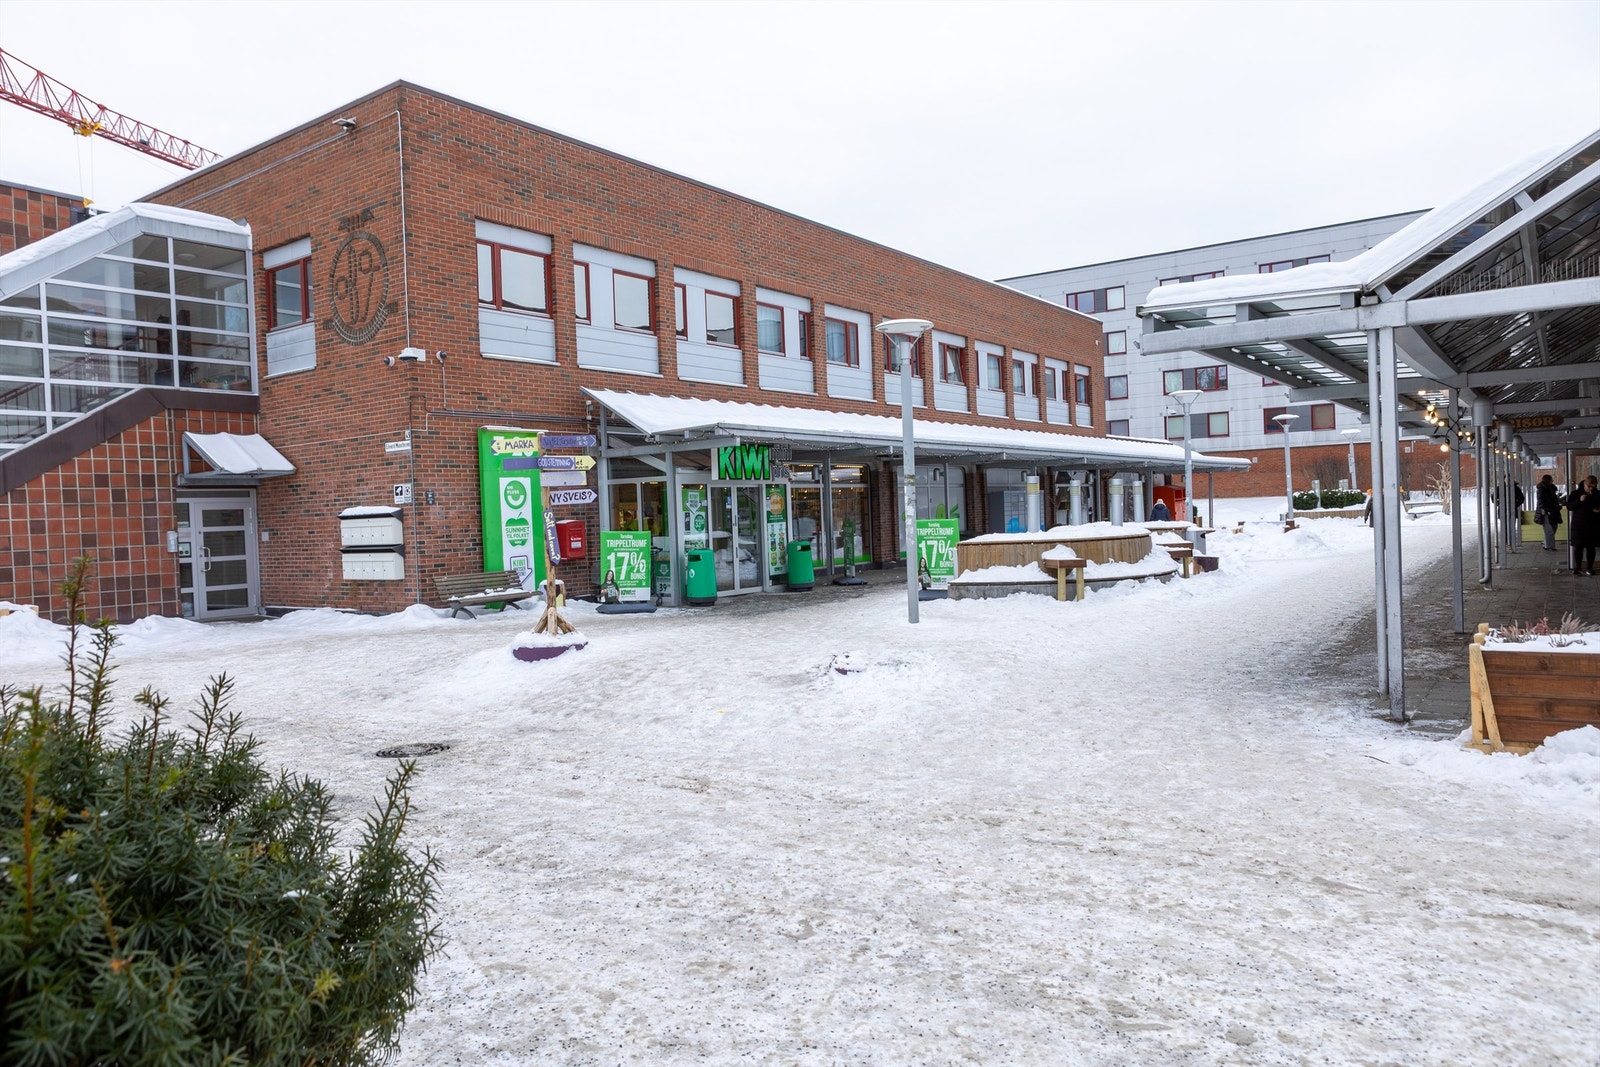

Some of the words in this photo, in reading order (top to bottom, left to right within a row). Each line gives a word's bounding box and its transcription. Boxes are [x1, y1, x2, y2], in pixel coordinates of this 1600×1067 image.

[504, 439, 534, 451] MARKA
[718, 444, 770, 480] KIWI
[550, 490, 562, 503] NY
[562, 490, 593, 502] SVEIS?
[505, 526, 529, 534] SUNNHET
[917, 527, 954, 536] TRIPPELTRUMF
[606, 539, 647, 547] TRIPPELTRUMF
[918, 540, 954, 568] 17%
[607, 552, 646, 580] 17%
[630, 572, 646, 580] BONUS
